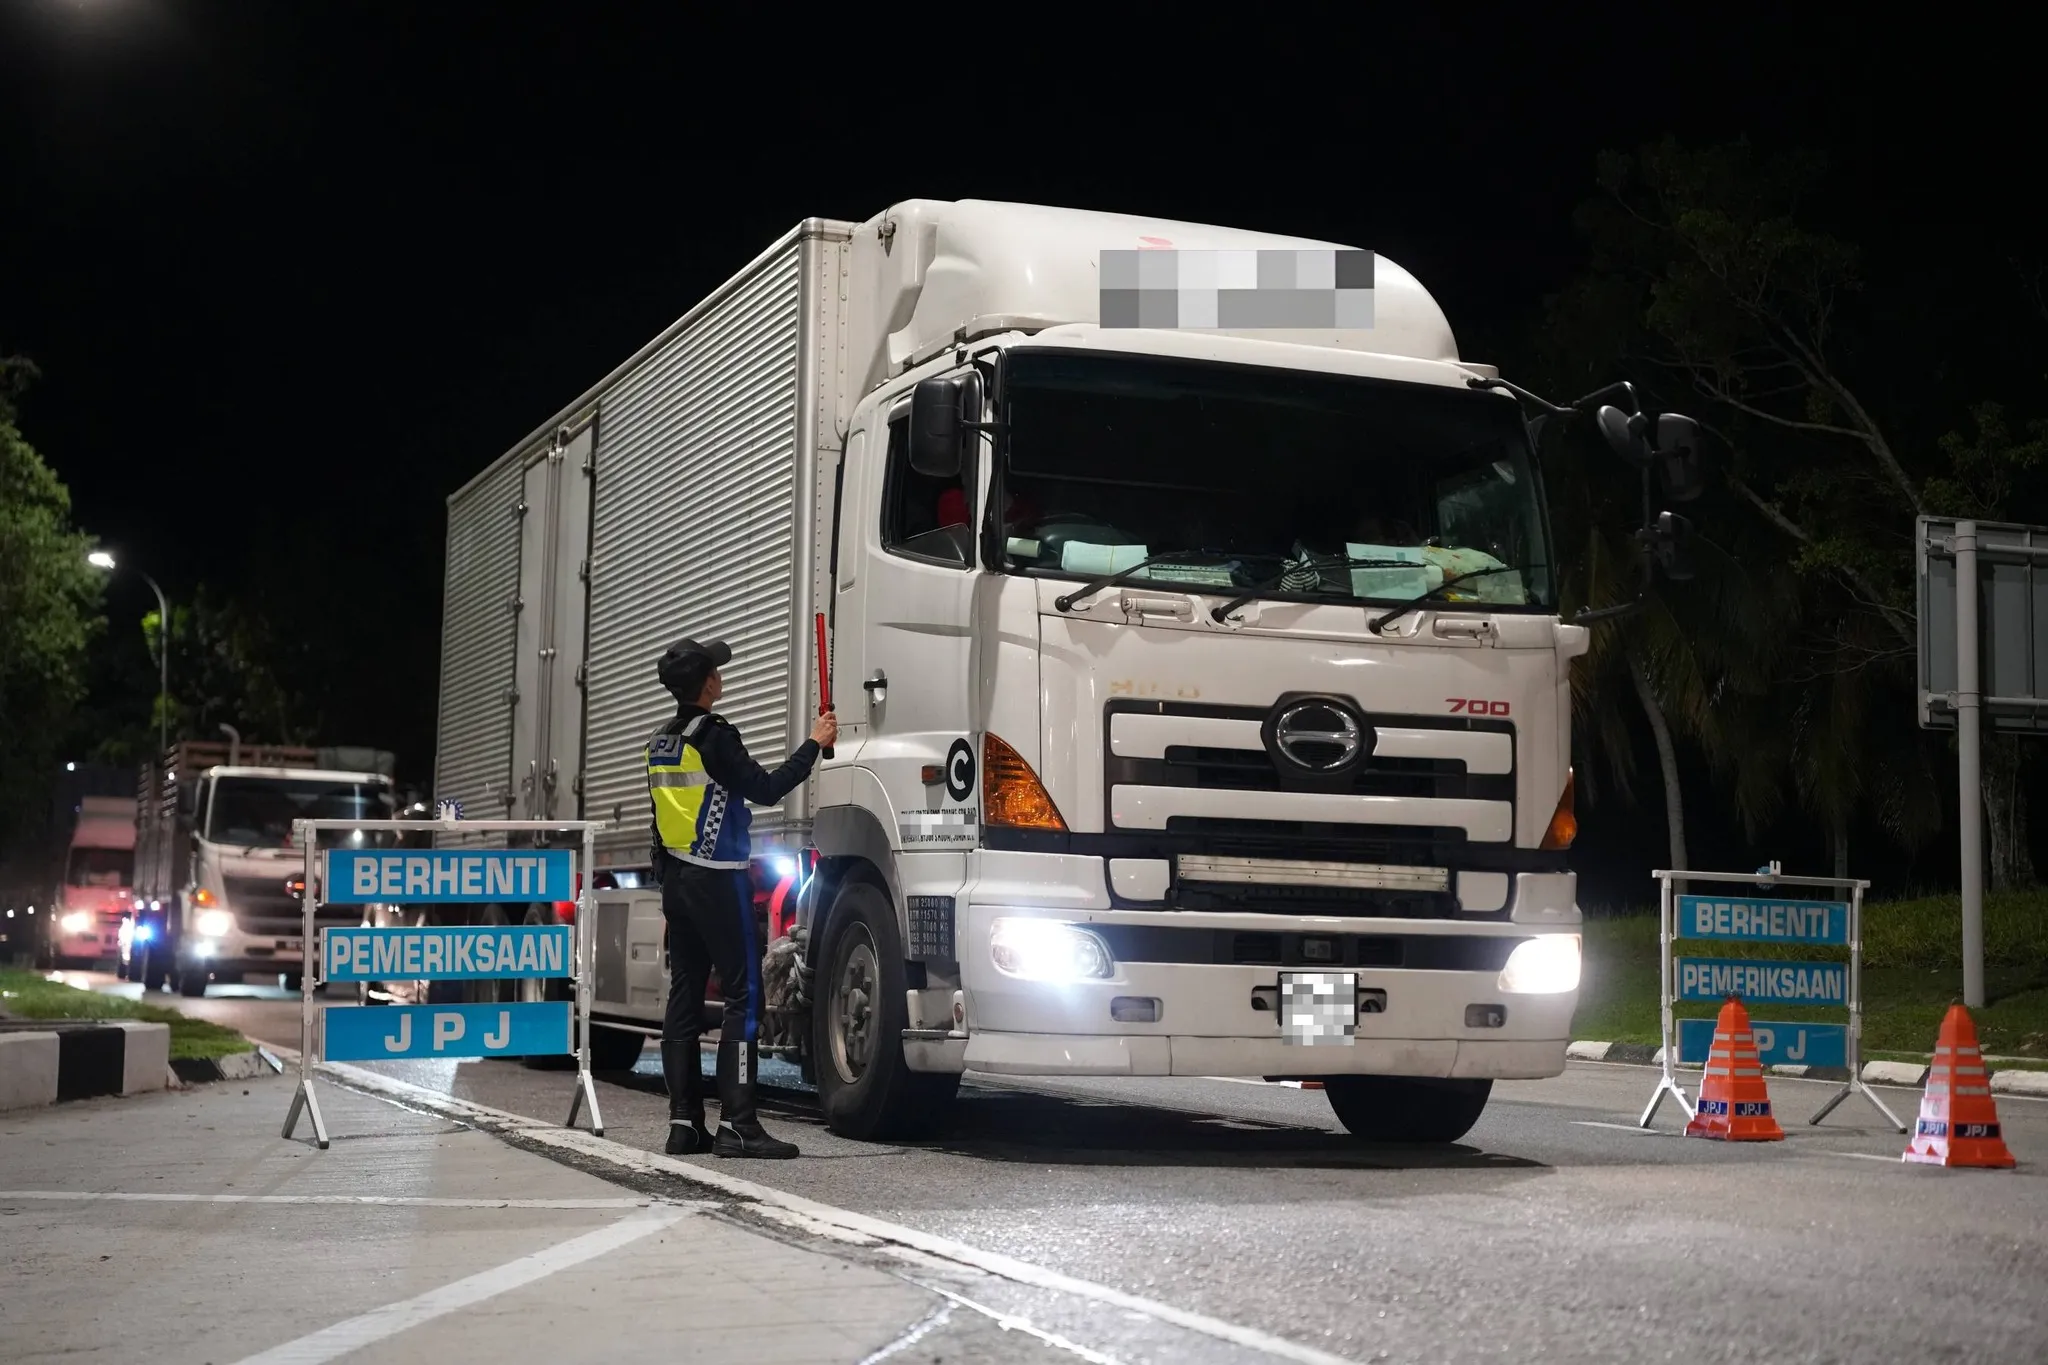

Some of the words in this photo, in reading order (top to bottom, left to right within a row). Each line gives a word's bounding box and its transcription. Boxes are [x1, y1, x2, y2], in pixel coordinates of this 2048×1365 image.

[1445, 698, 1511, 716] 700
[353, 857, 547, 896] BERHENTI
[1695, 902, 1830, 939] BERHENTI
[330, 933, 562, 975] PEMERIKSAAN
[1683, 963, 1842, 1000] PEMERIKSAAN
[1703, 1100, 1721, 1114] JPJ
[1741, 1103, 1761, 1116] JPJ
[1964, 1124, 1988, 1137] JPJ
